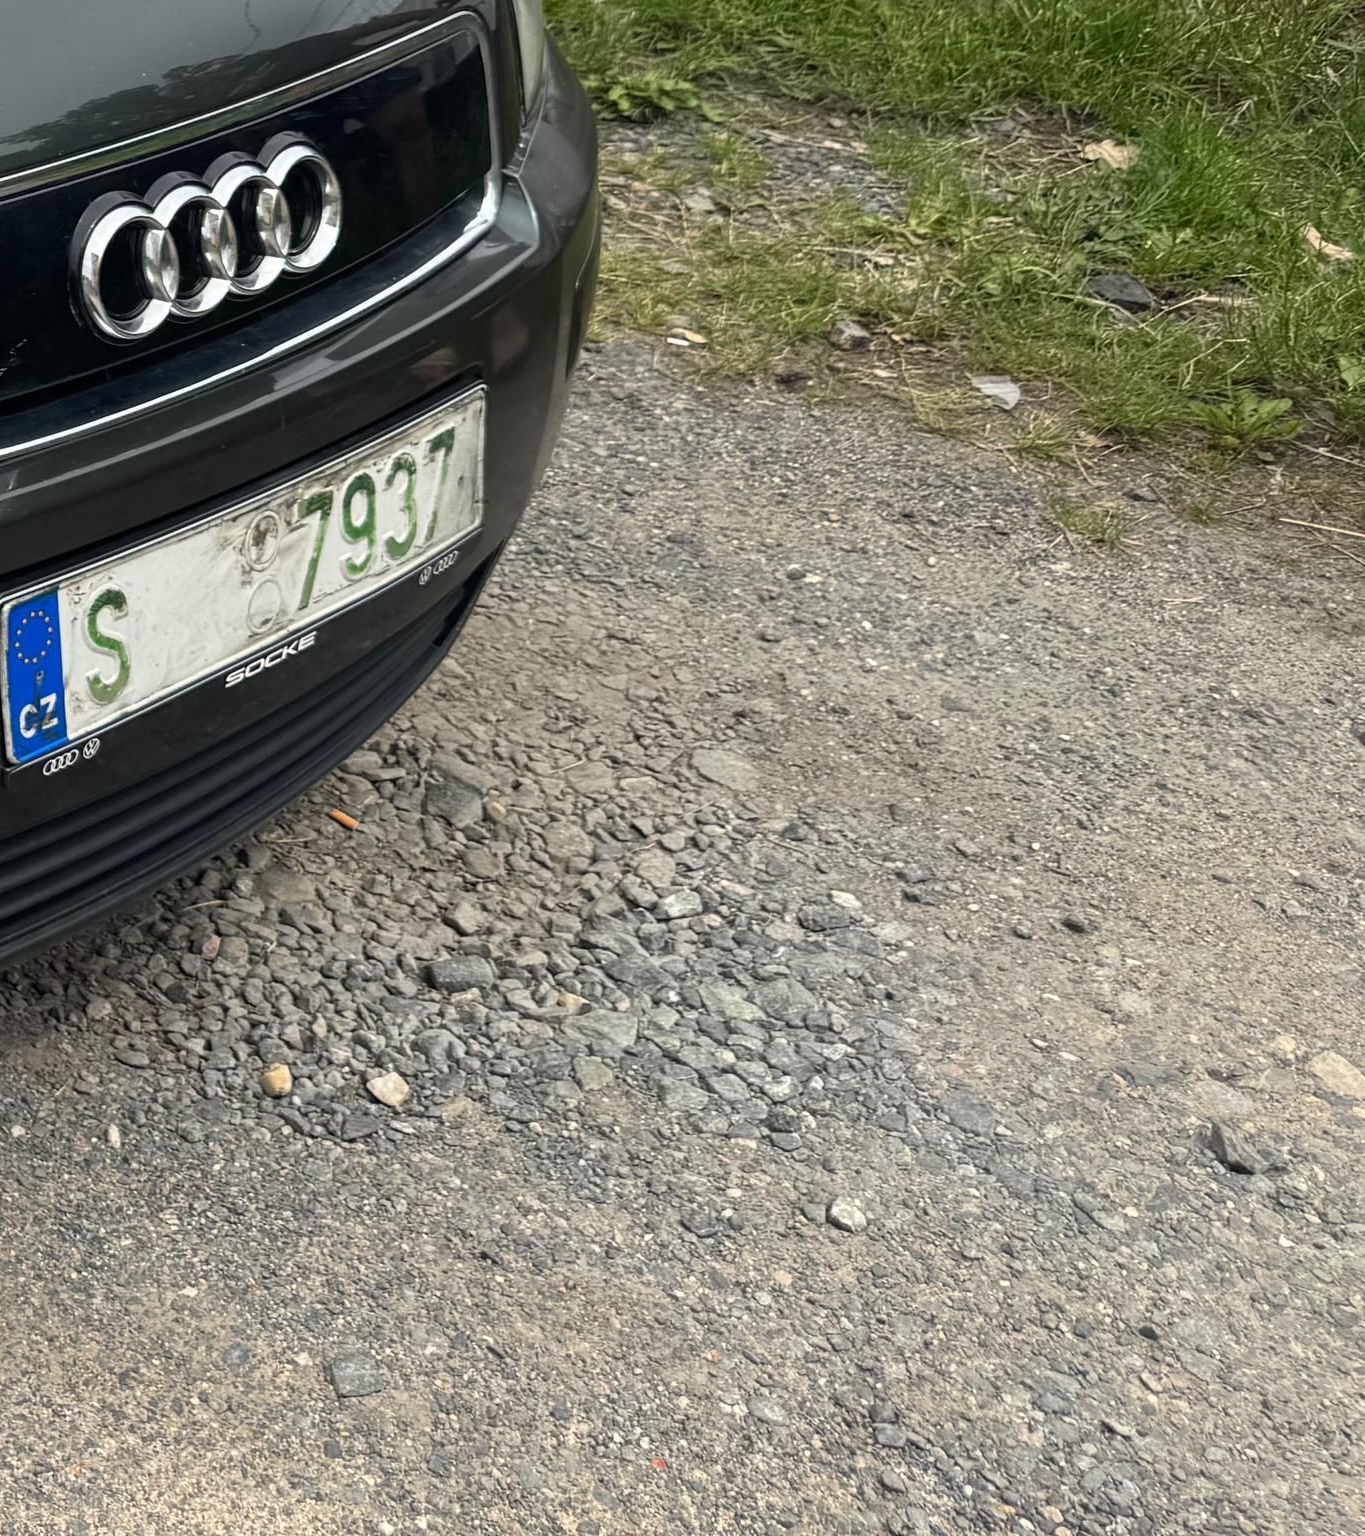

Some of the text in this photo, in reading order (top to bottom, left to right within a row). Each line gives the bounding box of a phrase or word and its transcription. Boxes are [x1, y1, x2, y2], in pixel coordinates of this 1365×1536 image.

[85, 424, 456, 705] S 7937
[224, 630, 317, 689] SOCKE
[19, 692, 58, 739] CZ
